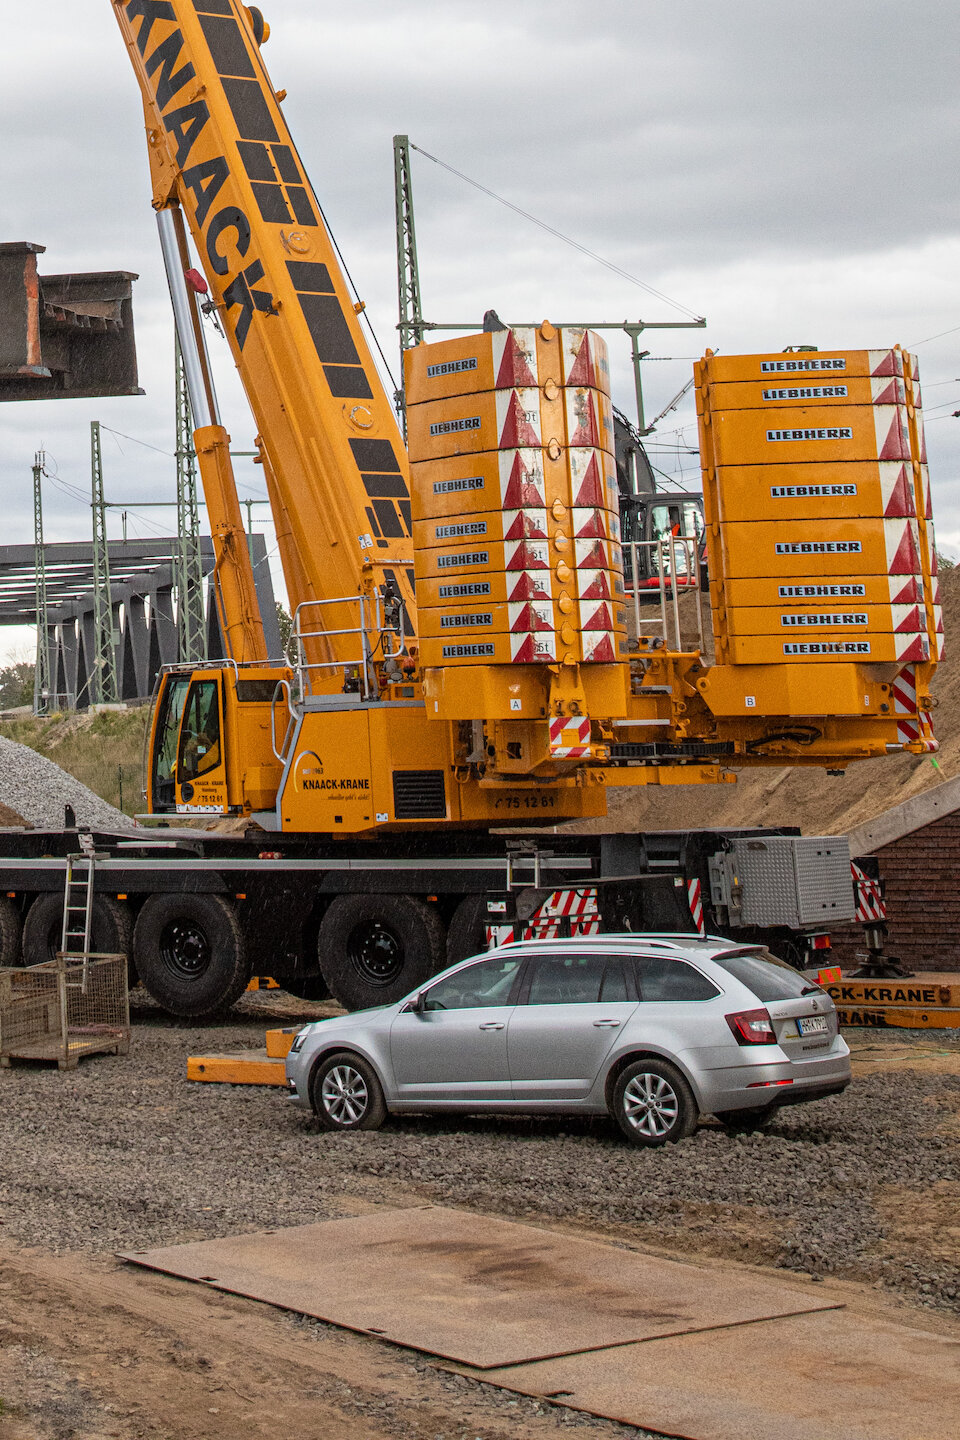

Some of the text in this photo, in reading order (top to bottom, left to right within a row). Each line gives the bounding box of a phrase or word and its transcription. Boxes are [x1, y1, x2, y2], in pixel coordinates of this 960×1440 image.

[428, 359, 477, 376] LIEBHERR
[761, 359, 845, 372] LIEBHERR
[764, 387, 846, 399] LIEBHERR
[430, 418, 480, 435] LIEBHERR
[767, 428, 852, 440] LIEBHERR
[433, 478, 483, 494] LIEBHERR
[771, 485, 856, 497] LIEBHERR
[436, 523, 486, 538] LIEBHERR
[776, 542, 860, 553] LIEBHERR
[438, 552, 488, 568] LIEBHERR
[439, 584, 490, 597] LIEBHERR
[780, 586, 864, 596] LIEBHERR
[441, 614, 492, 627] LIEBHERR
[783, 615, 866, 625] LIEBHERR
[443, 644, 494, 657] LIEBHERR
[784, 643, 869, 653] LIEBHERR
[512, 701, 519, 709] A
[747, 697, 754, 706] B
[303, 779, 370, 790] KNAACK-KRANE
[505, 796, 554, 808] 75 12 61
